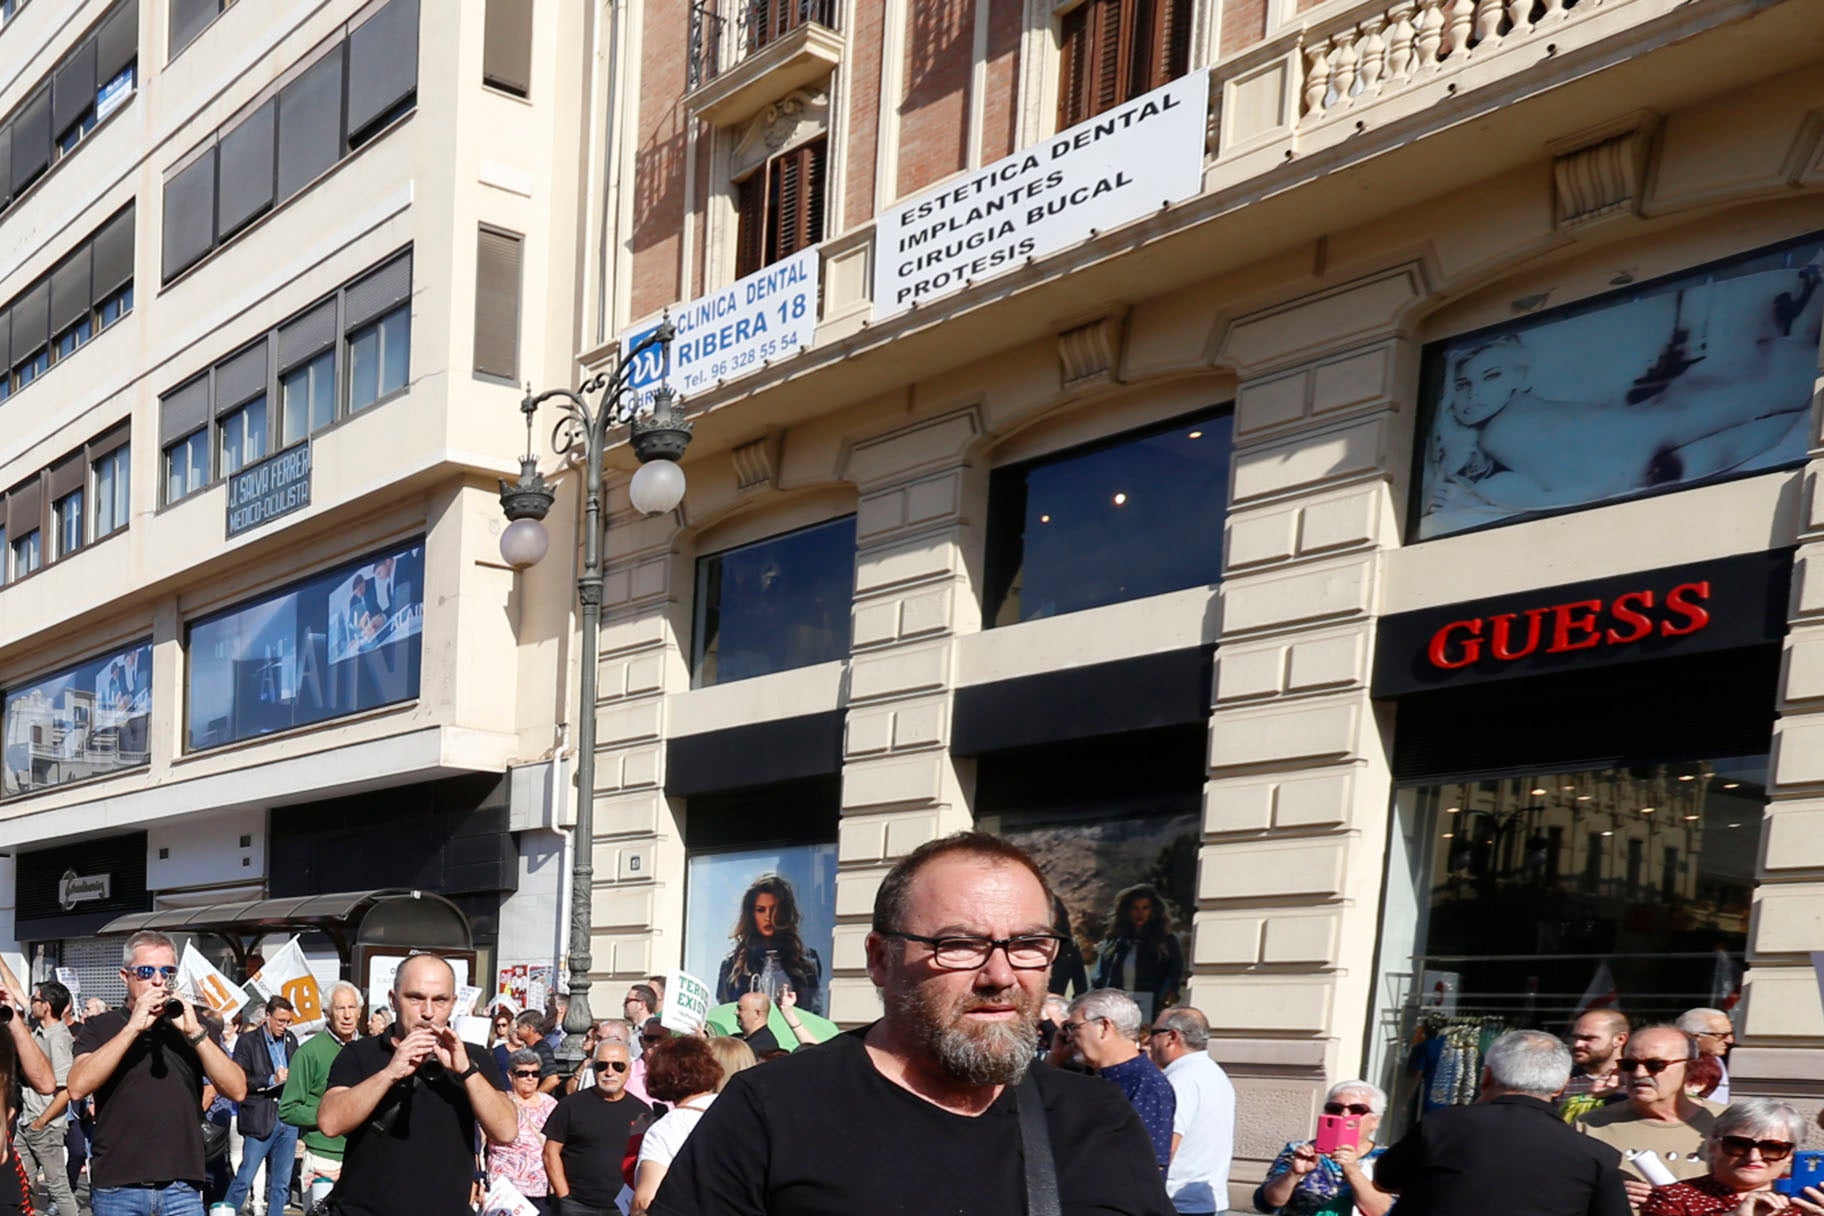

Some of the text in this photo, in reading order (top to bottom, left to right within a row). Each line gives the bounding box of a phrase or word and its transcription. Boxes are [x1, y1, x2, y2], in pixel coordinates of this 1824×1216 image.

[900, 93, 1181, 227] ESTETICA DENTAL
[897, 171, 1134, 278] CIRUGIA BUCAL
[899, 170, 1064, 253] IMPLANTES
[677, 260, 808, 335] CLINICA DENTAL
[897, 237, 1036, 304] PROTESIS
[678, 293, 806, 368] RIBERA 18
[684, 331, 798, 390] Tel. 96 328 55 54
[271, 448, 308, 489] FERRER
[230, 480, 308, 533] MEDICO-OCULISTA
[1428, 581, 1710, 669] GUESS
